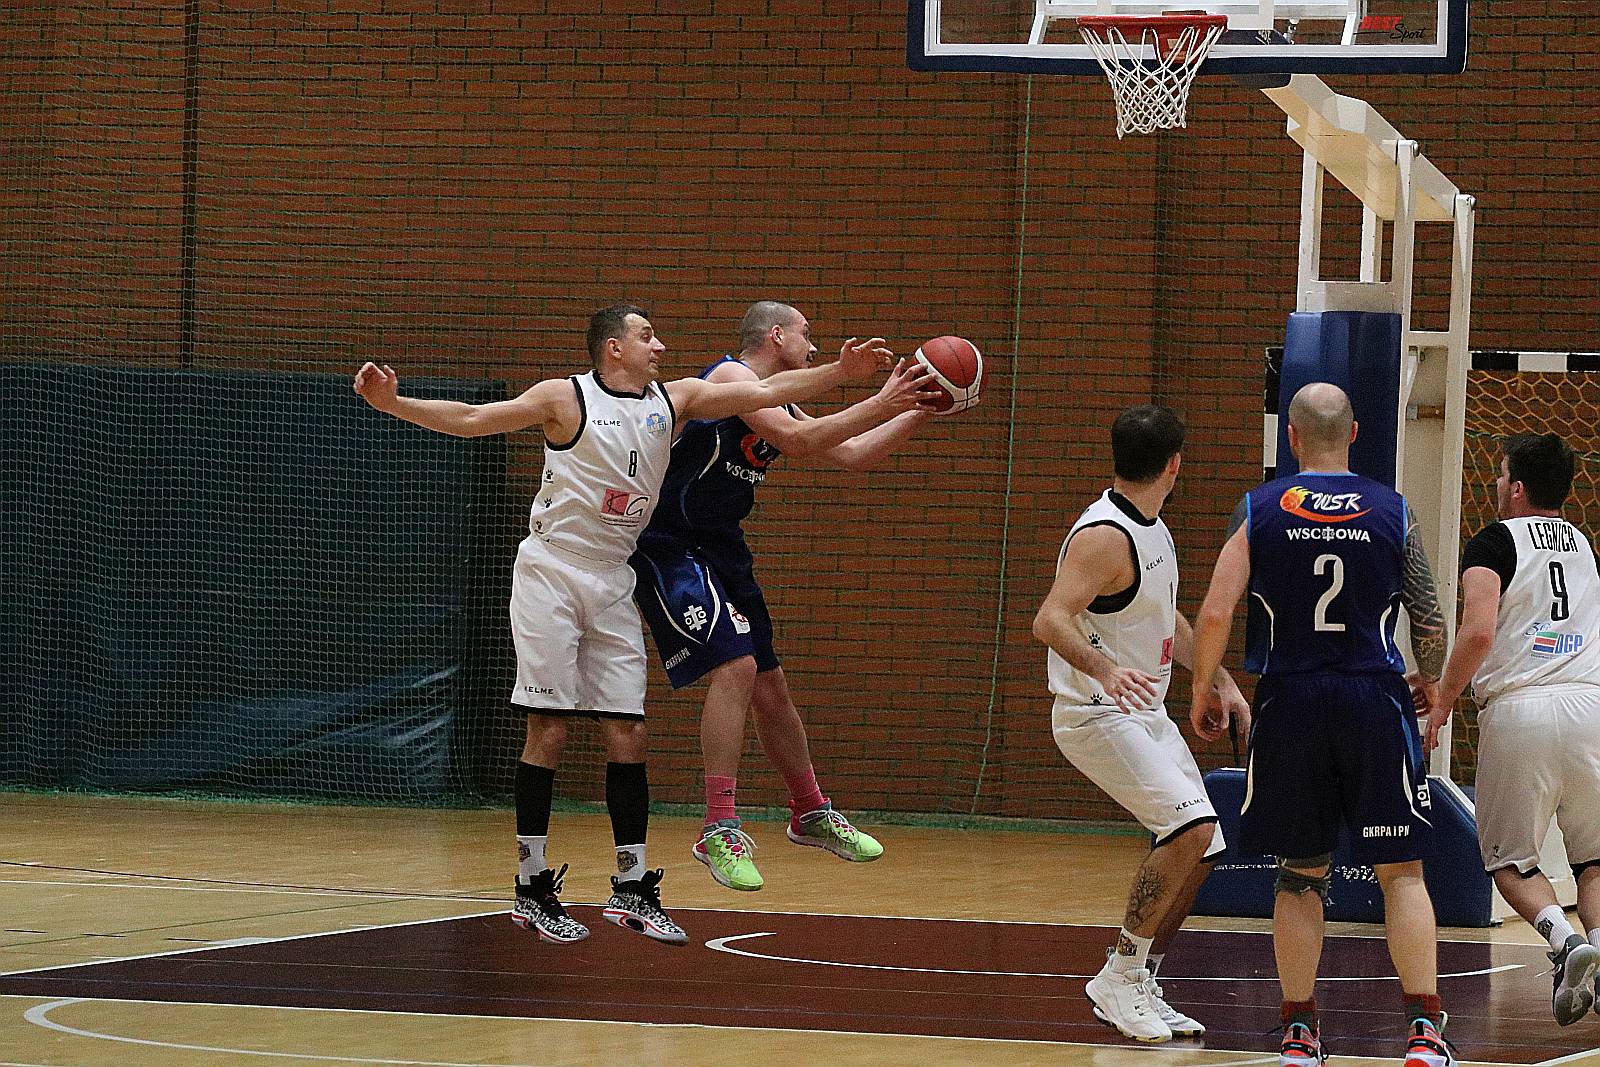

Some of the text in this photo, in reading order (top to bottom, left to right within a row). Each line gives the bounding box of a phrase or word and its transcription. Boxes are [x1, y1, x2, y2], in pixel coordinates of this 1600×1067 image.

[1360, 15, 1403, 30] BEST
[1389, 23, 1432, 43] Sport
[628, 450, 638, 478] 8
[1311, 492, 1363, 512] WSK
[1313, 553, 1346, 632] 2
[1548, 561, 1570, 622] 9
[1362, 825, 1392, 838] GKRPA
